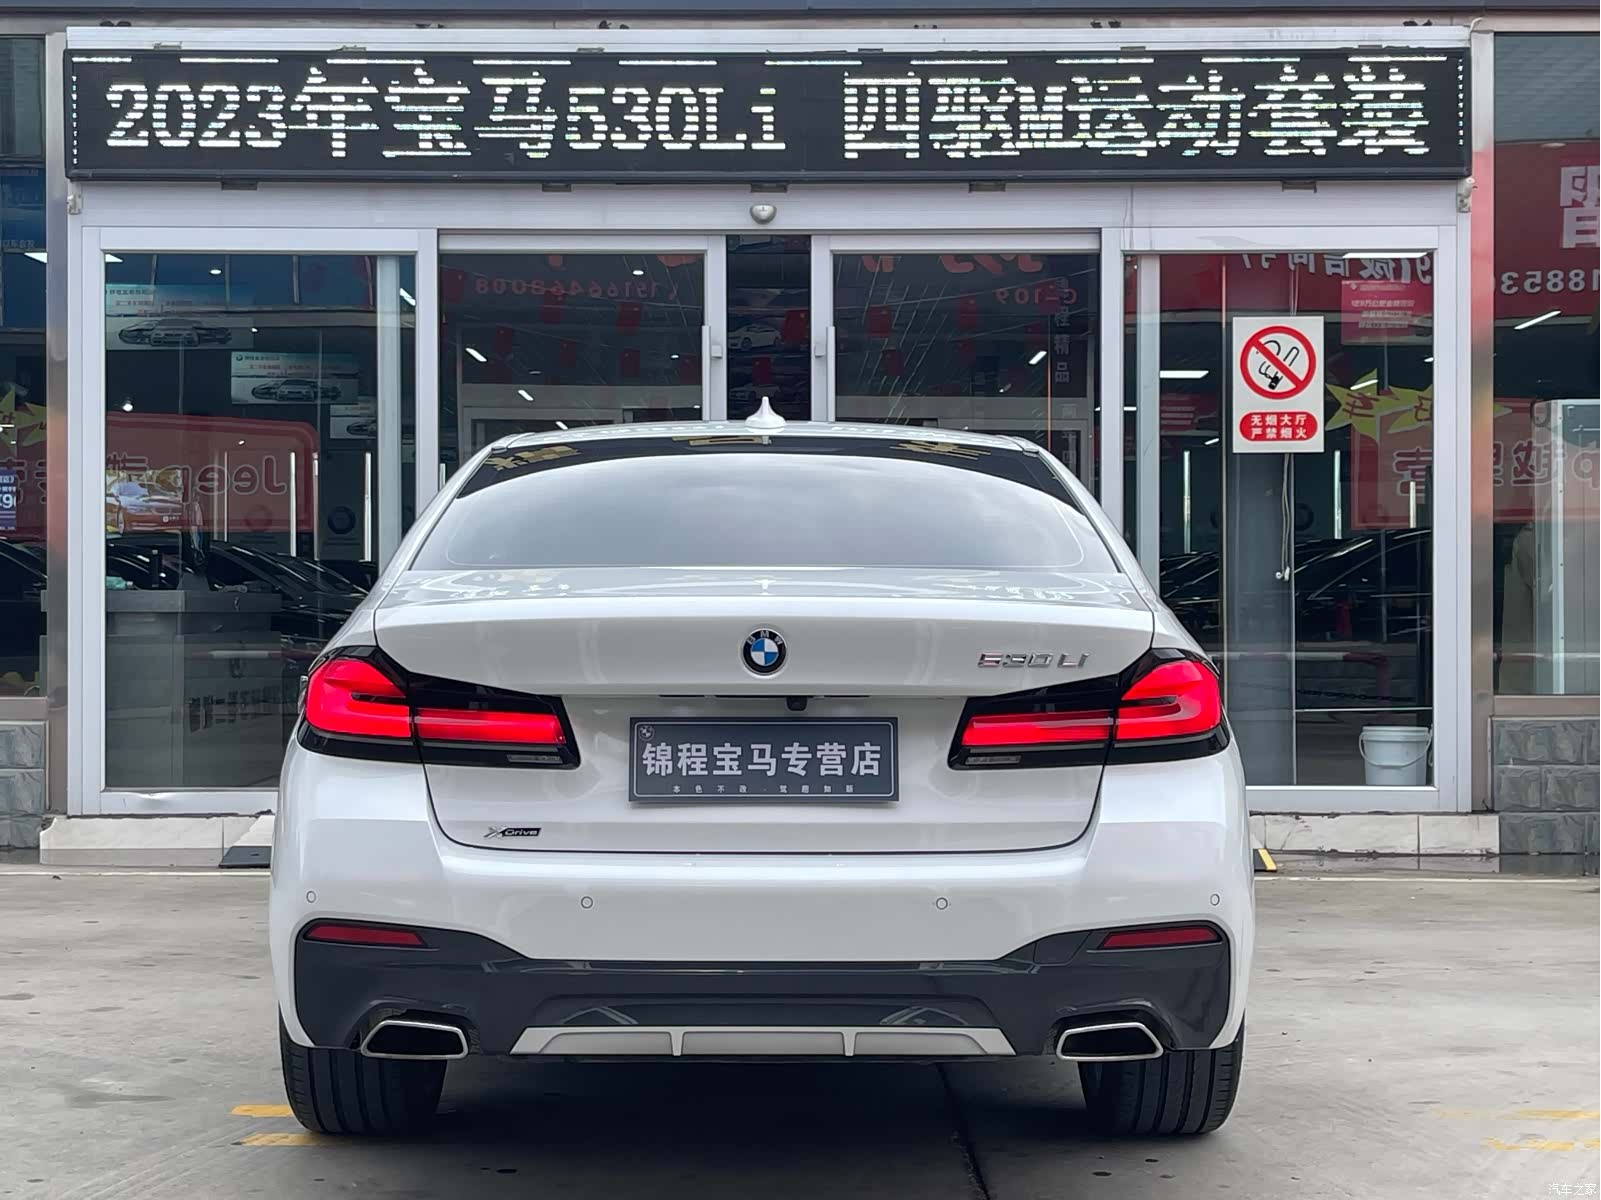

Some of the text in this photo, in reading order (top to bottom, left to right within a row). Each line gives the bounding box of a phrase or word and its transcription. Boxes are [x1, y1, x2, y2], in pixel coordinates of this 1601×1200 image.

[1251, 414, 1307, 426] 无烟大厅
[1251, 427, 1307, 439] 严禁烟火
[642, 742, 882, 777] 锦程宝马专营店
